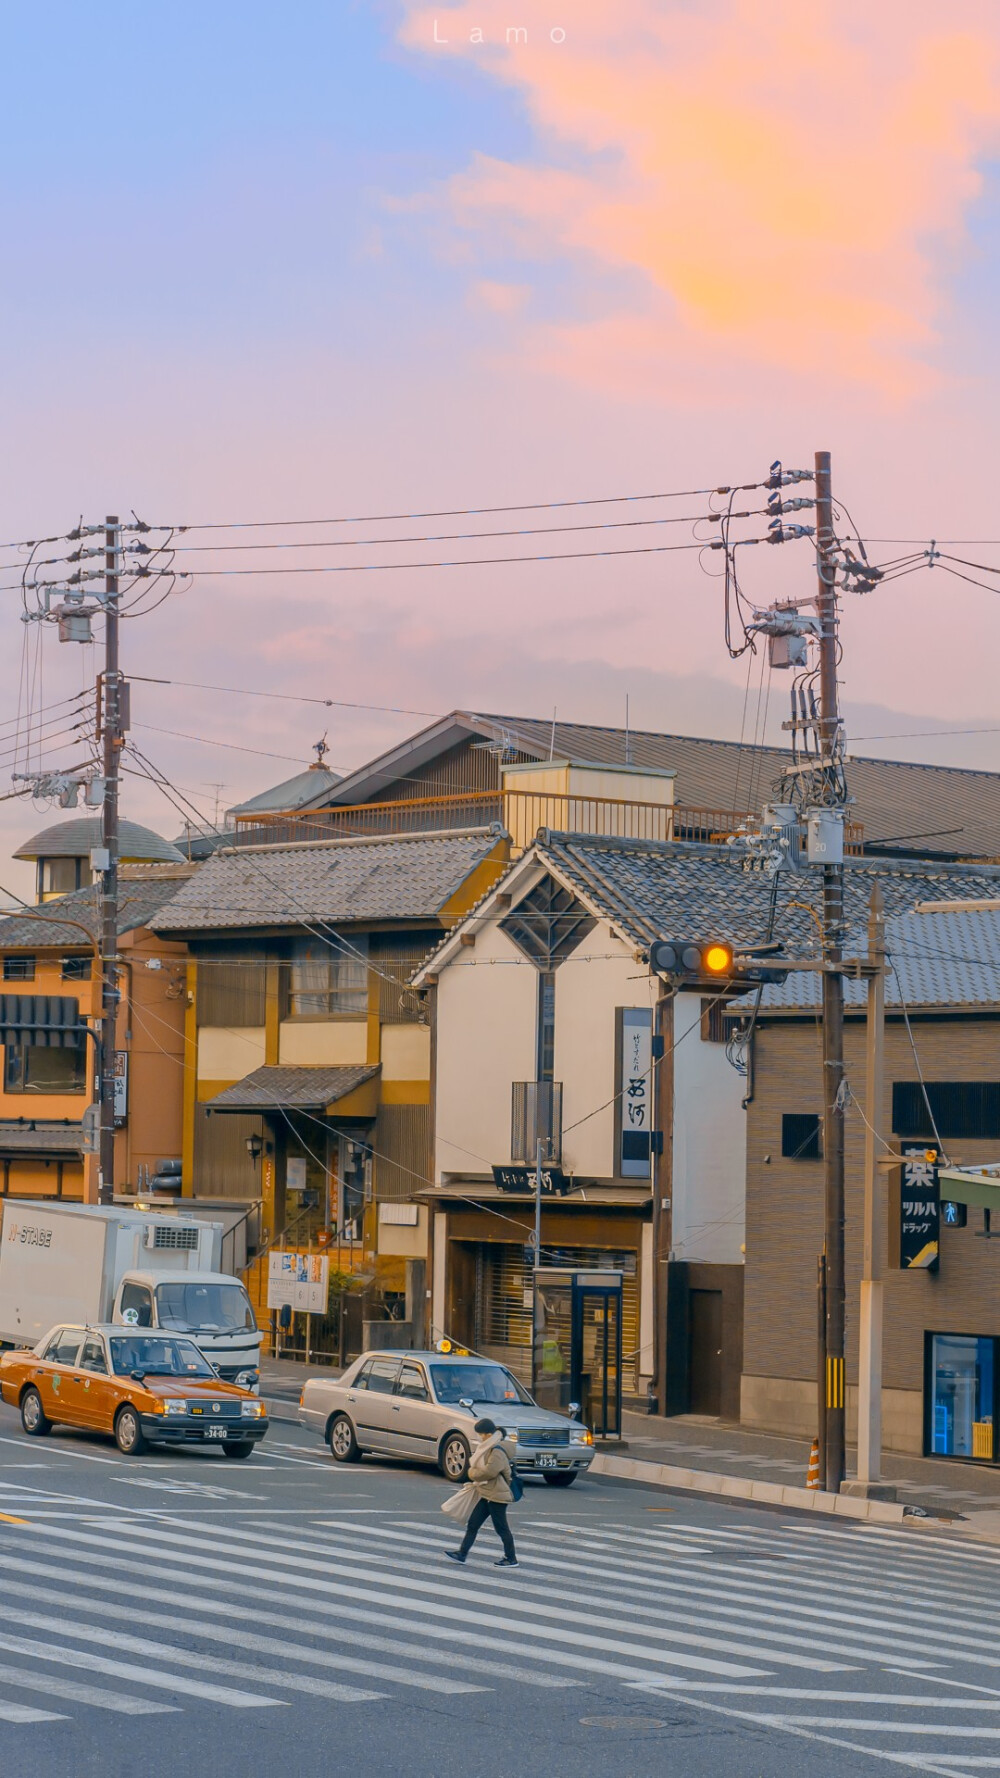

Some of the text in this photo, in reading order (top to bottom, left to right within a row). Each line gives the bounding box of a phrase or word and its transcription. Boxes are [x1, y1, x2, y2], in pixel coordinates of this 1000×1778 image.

[905, 1148, 935, 1187] 薬
[902, 1201, 937, 1217] ツルハ
[902, 1222, 931, 1234] ドラッグ
